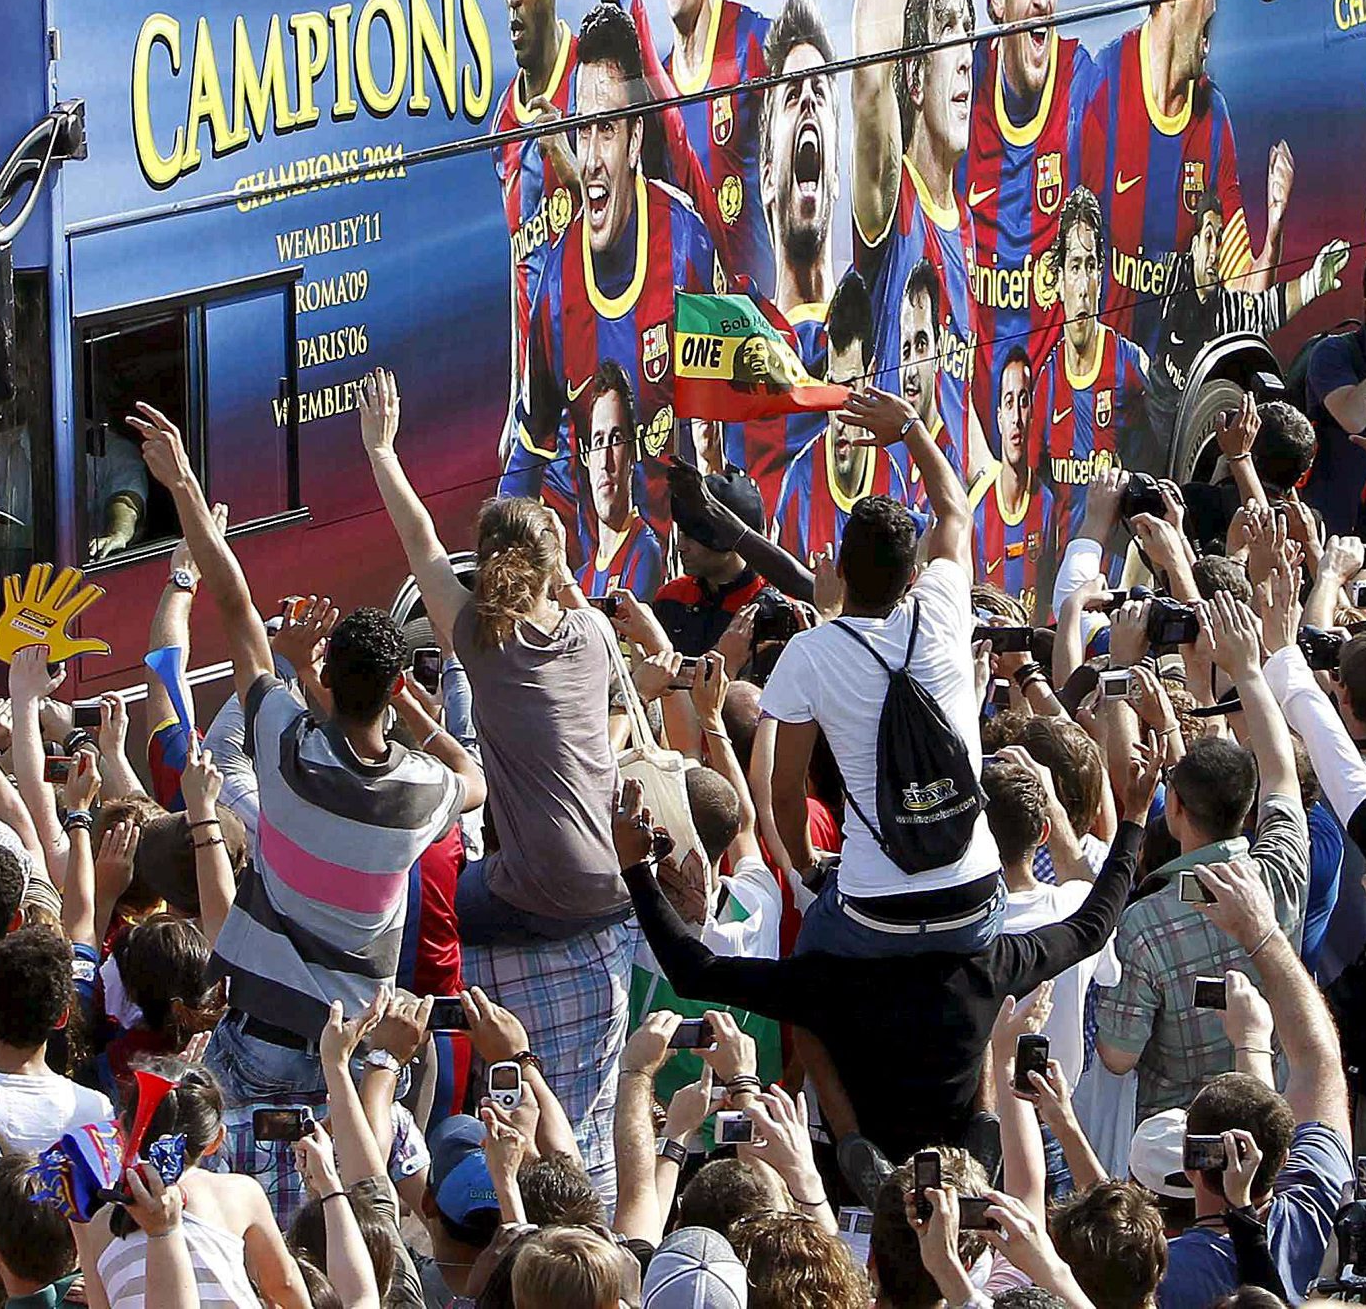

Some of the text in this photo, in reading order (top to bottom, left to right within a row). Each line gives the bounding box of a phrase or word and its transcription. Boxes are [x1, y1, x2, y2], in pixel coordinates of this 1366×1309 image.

[235, 146, 360, 212] CHAMPIONS
[276, 212, 382, 263] WEMBLEY'11
[513, 196, 549, 264] nicef
[295, 269, 368, 315] ROMA'09
[297, 325, 368, 369] PARIS'06
[720, 315, 751, 334] Bob
[681, 336, 724, 368] ONE
[1165, 353, 1186, 391] unic
